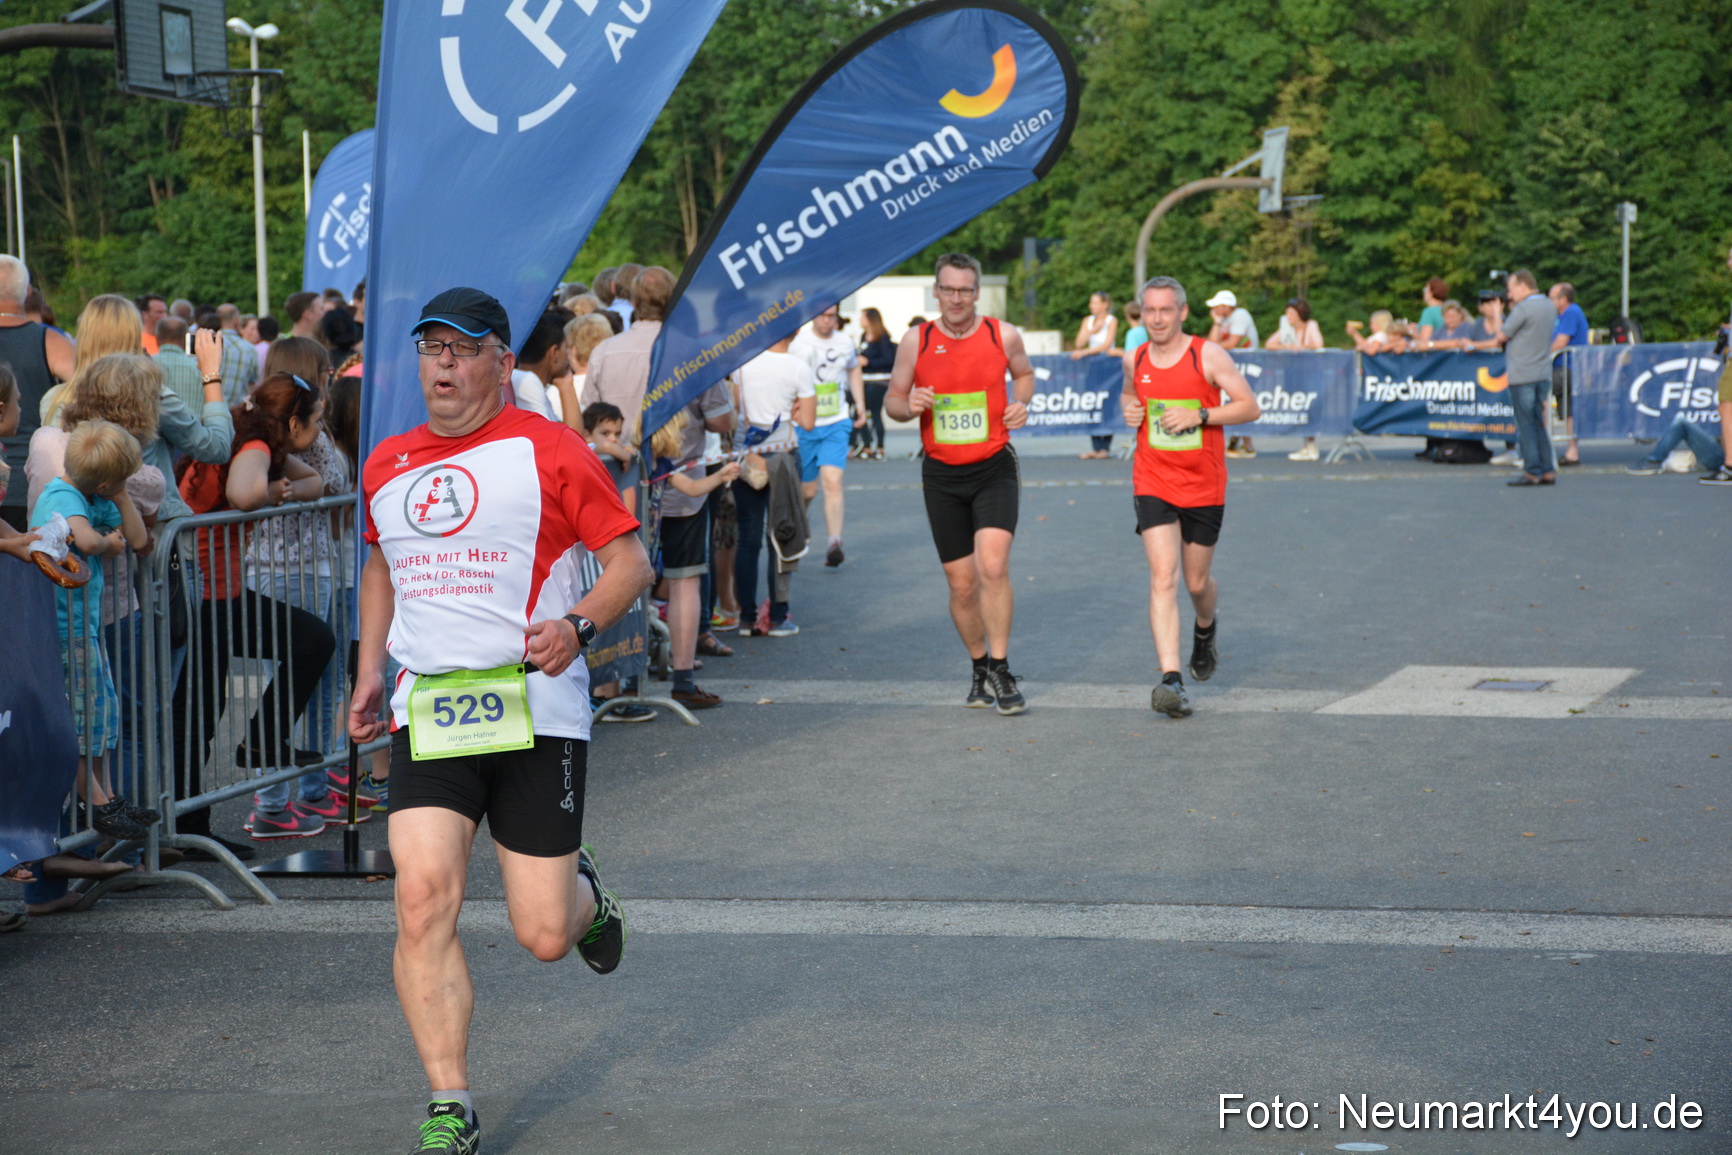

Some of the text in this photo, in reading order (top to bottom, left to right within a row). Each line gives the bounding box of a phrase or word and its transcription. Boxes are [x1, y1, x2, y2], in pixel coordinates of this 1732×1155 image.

[881, 107, 1054, 220] Druck und Medien
[718, 124, 969, 290] Frischmann
[641, 288, 805, 411] www.frischmann-net.de
[1364, 375, 1476, 402] Frischmann
[939, 412, 982, 430] 1380
[436, 552, 461, 563] MIT
[468, 548, 508, 563] HERZ
[399, 577, 410, 586] Dr.
[411, 571, 432, 582] Heck
[442, 571, 456, 579] Dr.
[459, 569, 494, 579] Röschl
[401, 583, 494, 601] Leistungsdiagnostik
[434, 692, 504, 728] 529
[446, 733, 472, 742] Jürgen
